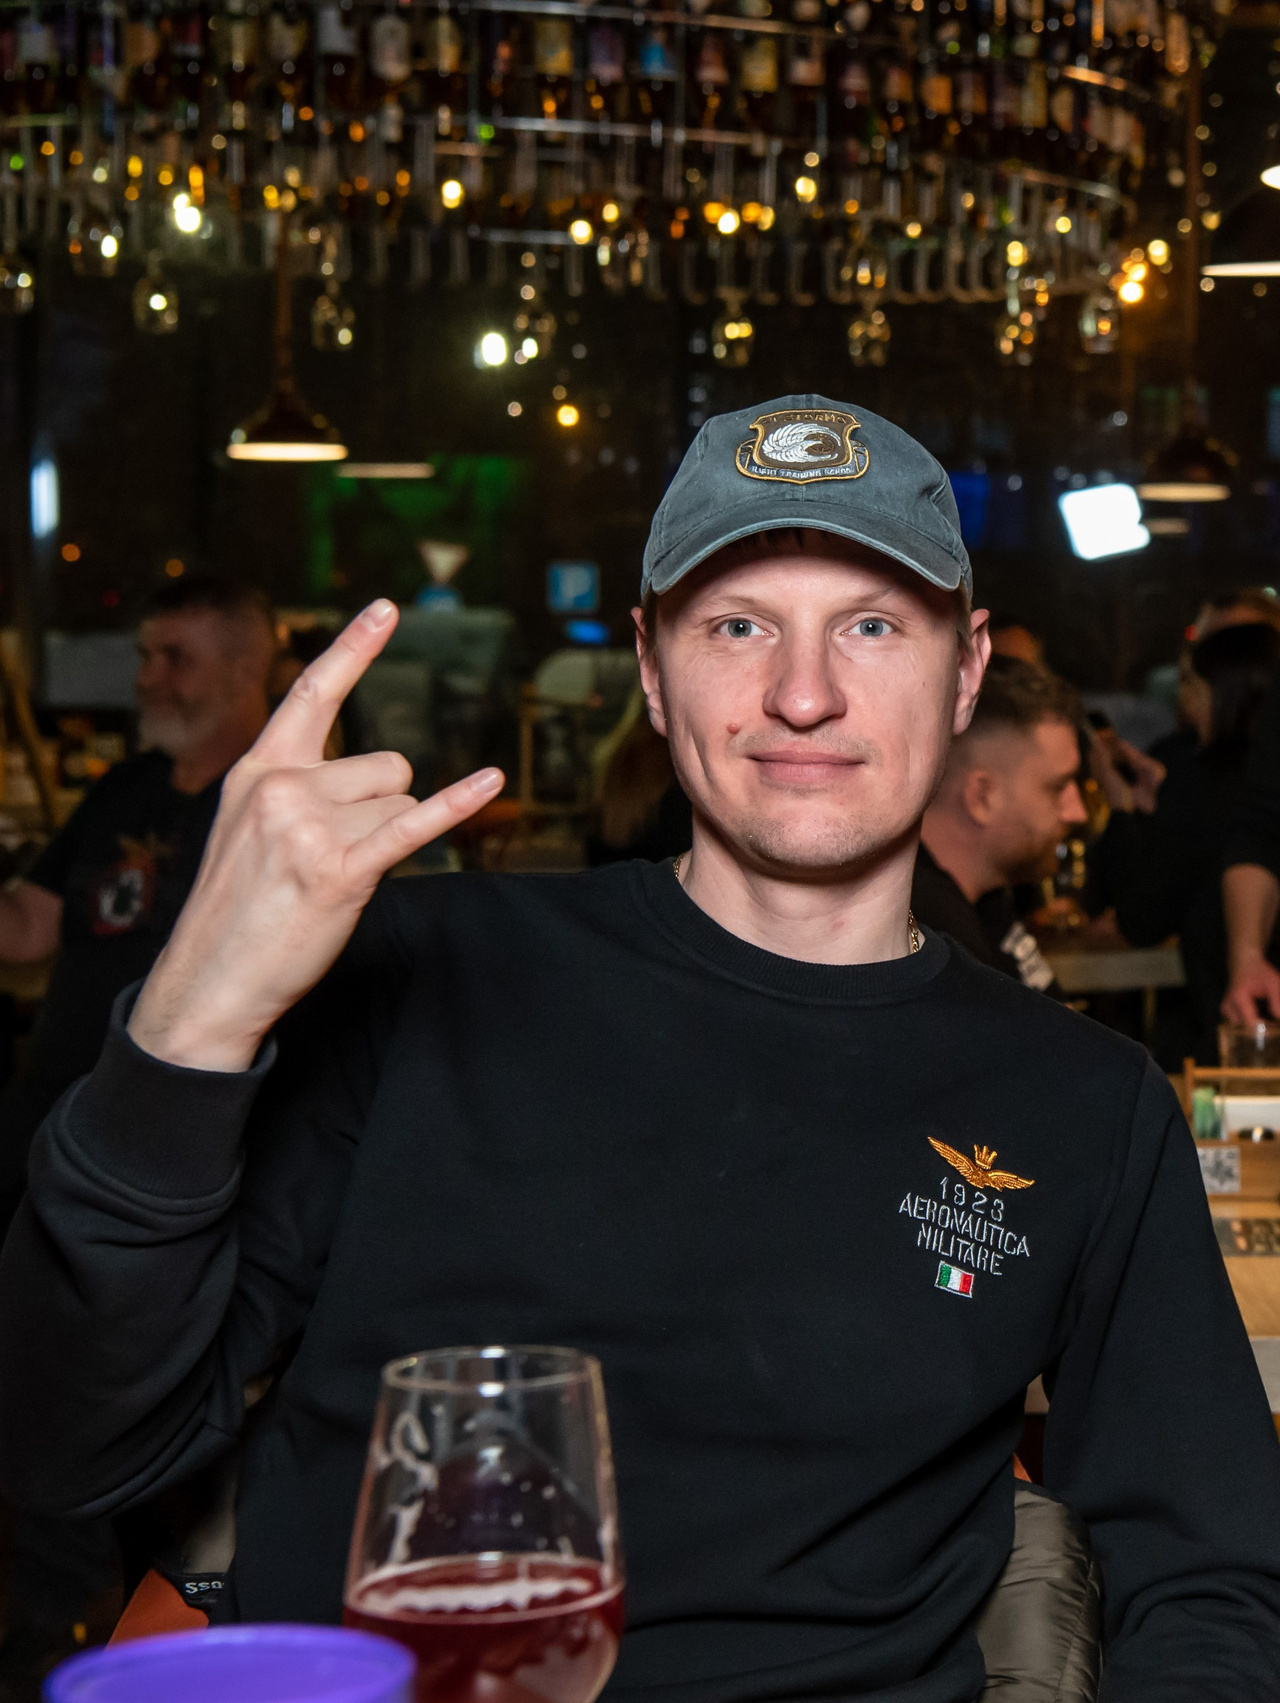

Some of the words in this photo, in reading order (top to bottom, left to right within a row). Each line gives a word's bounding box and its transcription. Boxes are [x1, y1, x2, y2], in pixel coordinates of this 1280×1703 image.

[899, 1192, 1030, 1257] AERONAUTICA
[939, 1176, 1004, 1222] 1923
[917, 1222, 1004, 1275] MILITARE
